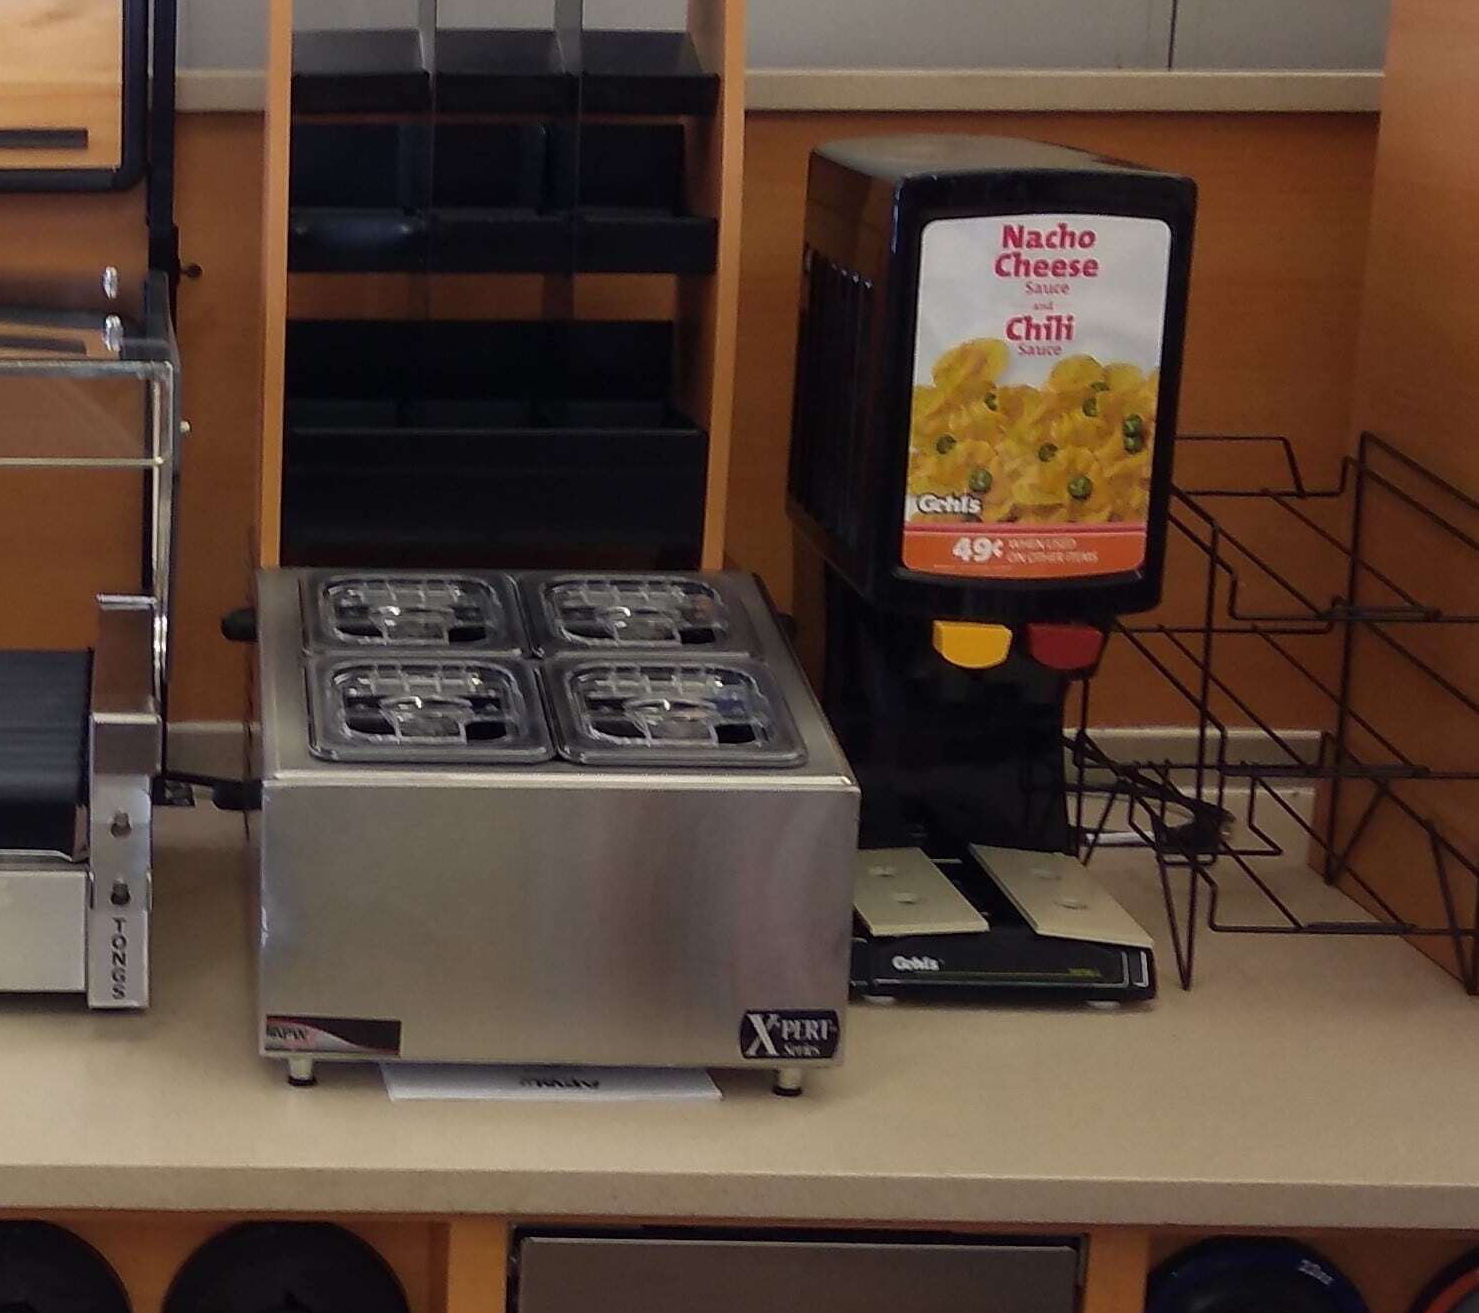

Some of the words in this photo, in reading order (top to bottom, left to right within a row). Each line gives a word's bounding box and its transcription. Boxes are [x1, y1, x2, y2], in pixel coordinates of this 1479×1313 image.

[1002, 223, 1096, 248] Nacho
[994, 251, 1099, 277] Cheese
[1025, 282, 1069, 294] Sauce
[1005, 315, 1074, 341] Chili
[1017, 344, 1063, 356] Sauce
[112, 916, 127, 1000] TONGS
